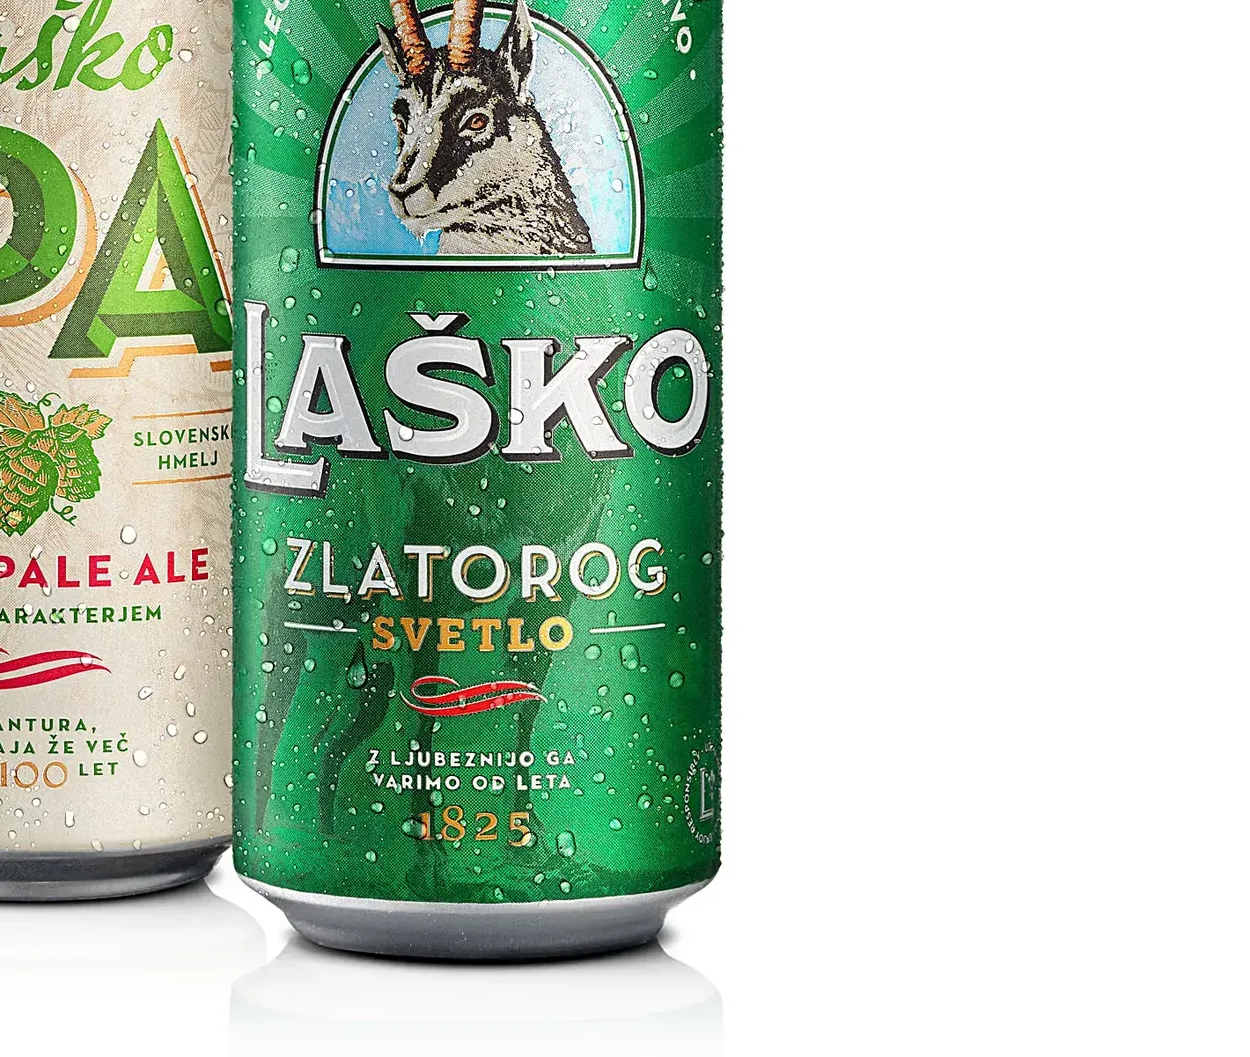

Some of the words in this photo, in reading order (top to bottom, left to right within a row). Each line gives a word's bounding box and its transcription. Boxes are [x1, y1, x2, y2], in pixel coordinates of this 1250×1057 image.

[243, 300, 710, 498] LAŠKO
[158, 450, 218, 470] HMELJ
[134, 547, 210, 586] ALE
[283, 537, 668, 603] ZLATOROG
[372, 616, 574, 652] SVETLO
[48, 733, 75, 754] ŽE
[87, 731, 129, 753] VEČ
[0, 761, 68, 788] 100
[79, 761, 118, 776] LET
[368, 750, 380, 765] Z
[391, 750, 535, 768] LJUBEZNIJO
[547, 750, 576, 766] GA
[372, 773, 461, 791] VARIMO
[472, 774, 505, 791] OD
[516, 773, 572, 790] LETA
[417, 805, 532, 847] 1825
